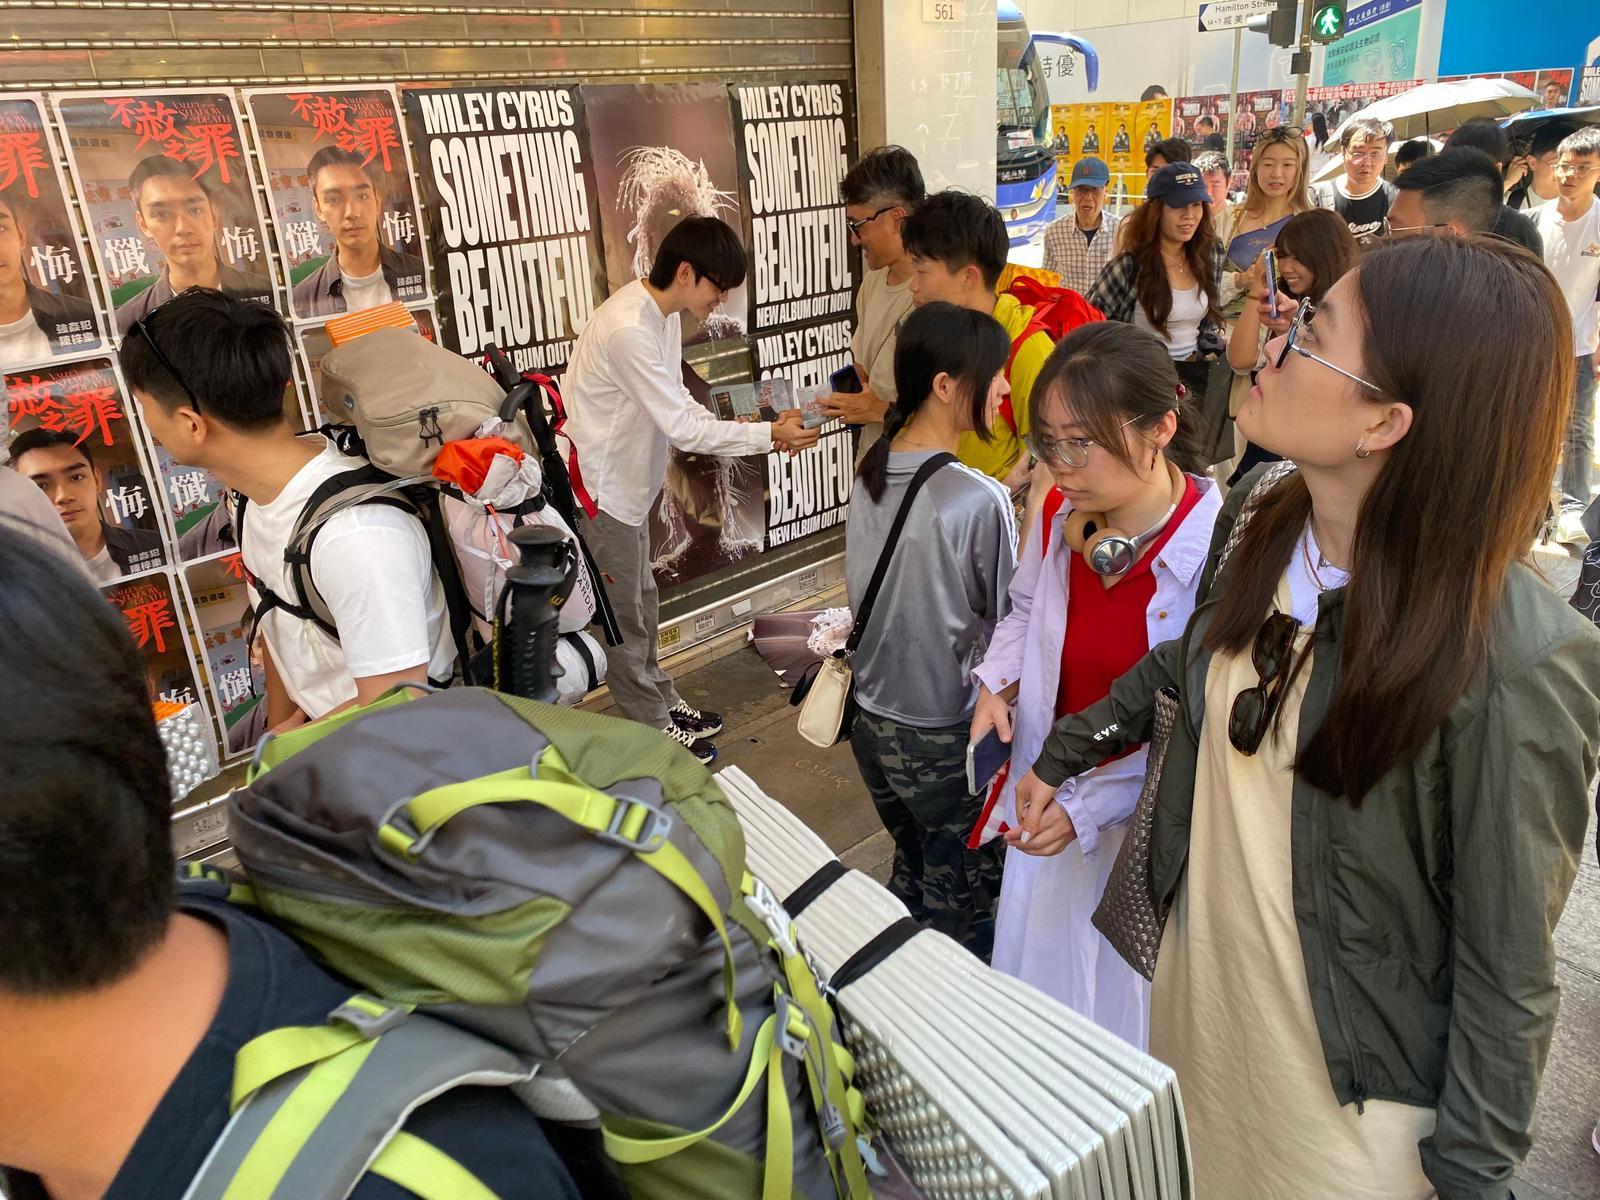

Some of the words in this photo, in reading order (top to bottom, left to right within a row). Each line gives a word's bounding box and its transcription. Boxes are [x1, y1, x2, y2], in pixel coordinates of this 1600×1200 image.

[934, 4, 955, 20] 561
[1215, 2, 1249, 13] Hamilton
[1251, 1, 1276, 9] Street
[418, 92, 495, 134] MILEY
[496, 89, 575, 130] CYRUS
[738, 86, 789, 120] MILEY
[790, 84, 844, 117] CYRUS
[744, 117, 848, 214] SOMETHING
[430, 130, 591, 249] SOMETHING
[752, 206, 852, 305] BEAUTIFUL
[756, 304, 780, 329] NEW
[780, 298, 812, 324] ALBUM
[811, 295, 830, 317] OUT
[830, 290, 852, 313] NOW
[545, 340, 571, 367] OUT
[757, 329, 803, 368] MILEY
[805, 319, 851, 357] CYRUS
[768, 527, 790, 548] NEW
[790, 514, 821, 540] ALBUM
[821, 508, 838, 529] OUT
